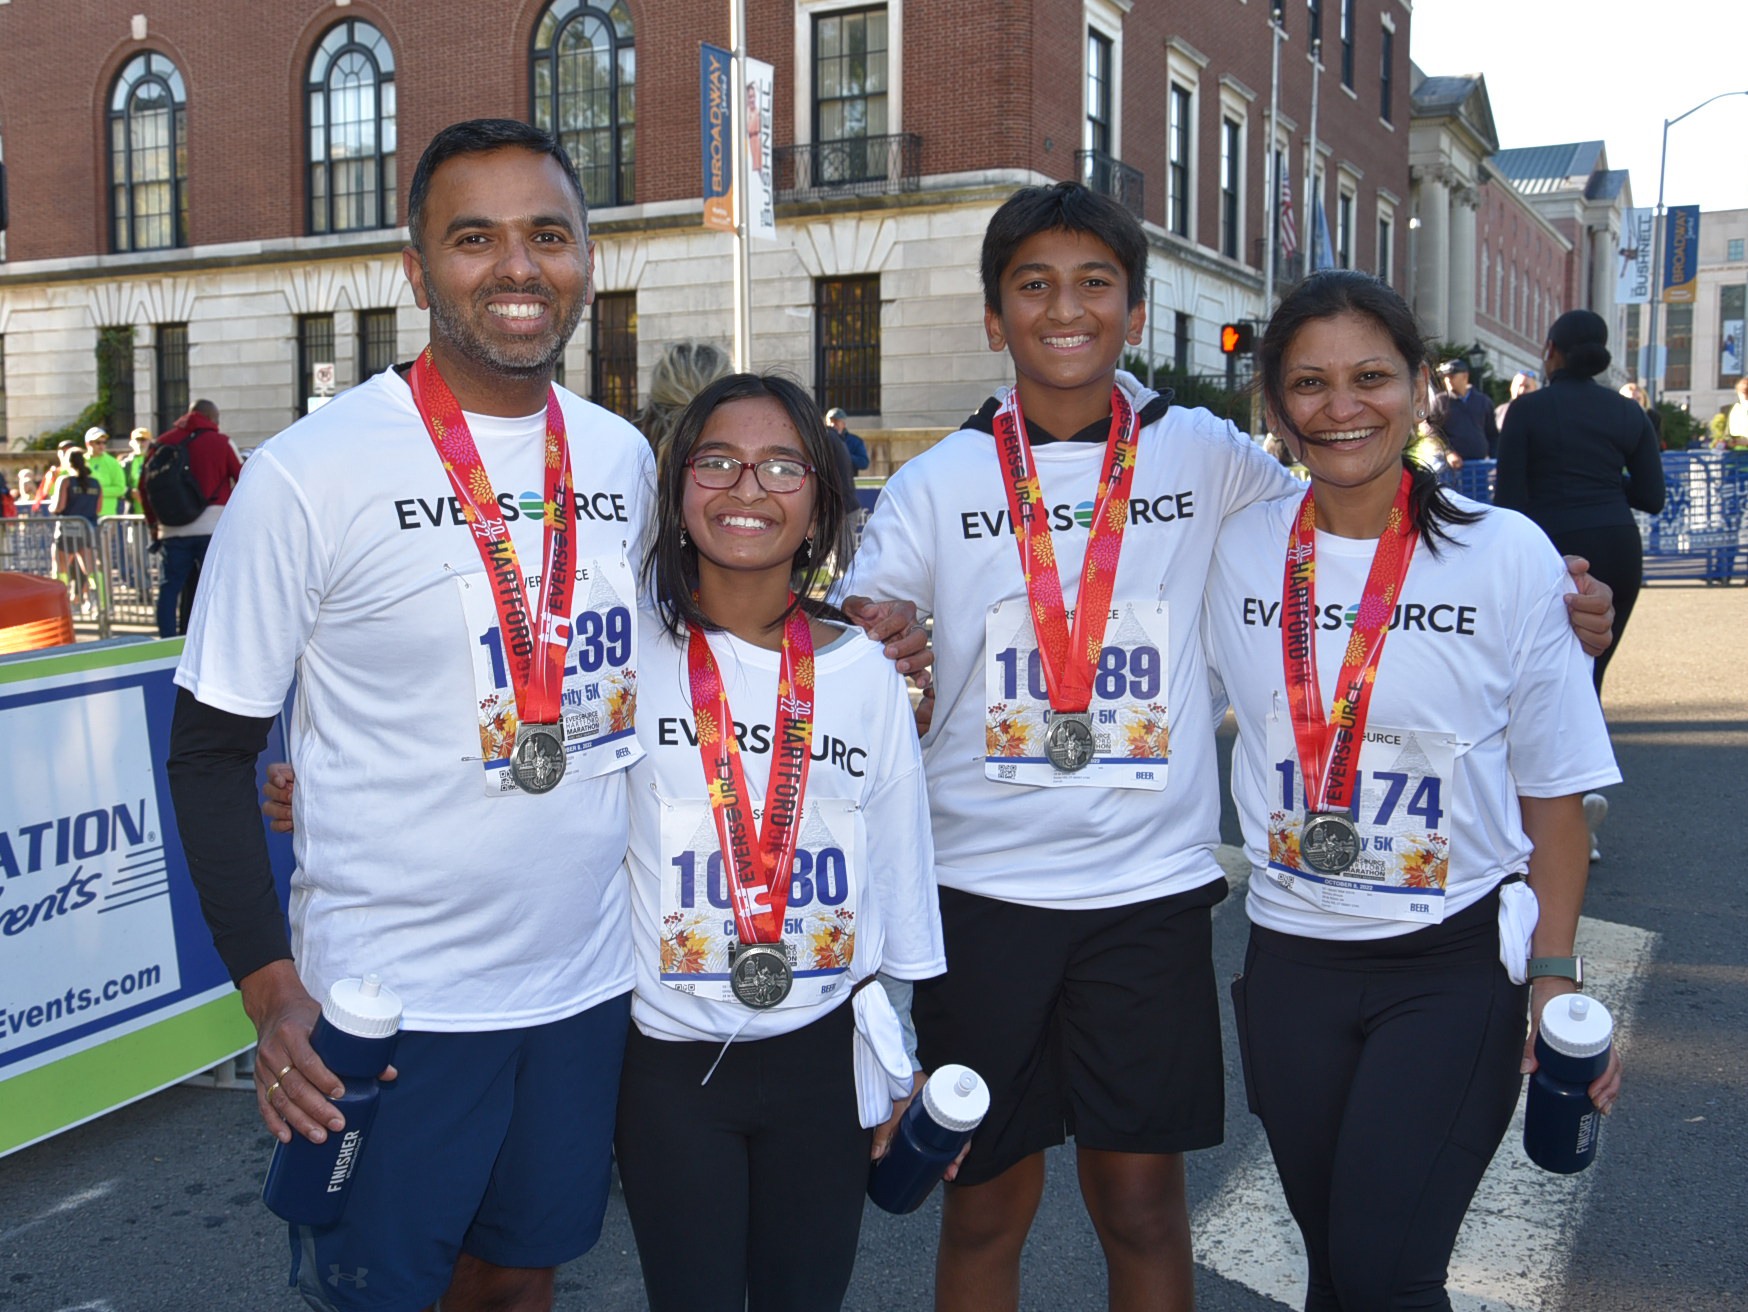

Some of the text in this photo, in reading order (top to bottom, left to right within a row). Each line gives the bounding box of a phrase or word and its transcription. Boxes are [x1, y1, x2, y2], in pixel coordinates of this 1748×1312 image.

[709, 55, 723, 192] BROADWAY
[761, 80, 773, 228] BUSHNELL
[1635, 215, 1653, 297] BUSHNELL
[1672, 210, 1687, 284] BROADWAY
[394, 490, 629, 530] EVESORCE
[471, 521, 491, 539] 22
[485, 516, 506, 537] 20
[1300, 541, 1313, 558] 20
[484, 539, 534, 657] HARTFORD
[1287, 560, 1310, 660] HARTFORD
[480, 606, 632, 689] 139
[585, 682, 601, 702] 5K
[995, 645, 1161, 701] 1089
[779, 696, 797, 714] 22
[795, 699, 812, 716] 20
[1099, 709, 1117, 725] 5K
[615, 746, 632, 759] BEER
[770, 718, 808, 827] HARTFORD
[1135, 771, 1155, 780] BEER
[1275, 758, 1444, 830] 1174
[1373, 836, 1394, 851] 5K
[671, 847, 850, 910] 1080
[1324, 878, 1355, 890] OCTOBER
[784, 918, 804, 935] 5K
[1409, 902, 1430, 913] BEER
[1575, 1110, 1595, 1155] FINISHER
[326, 1129, 361, 1193] FINISHER
